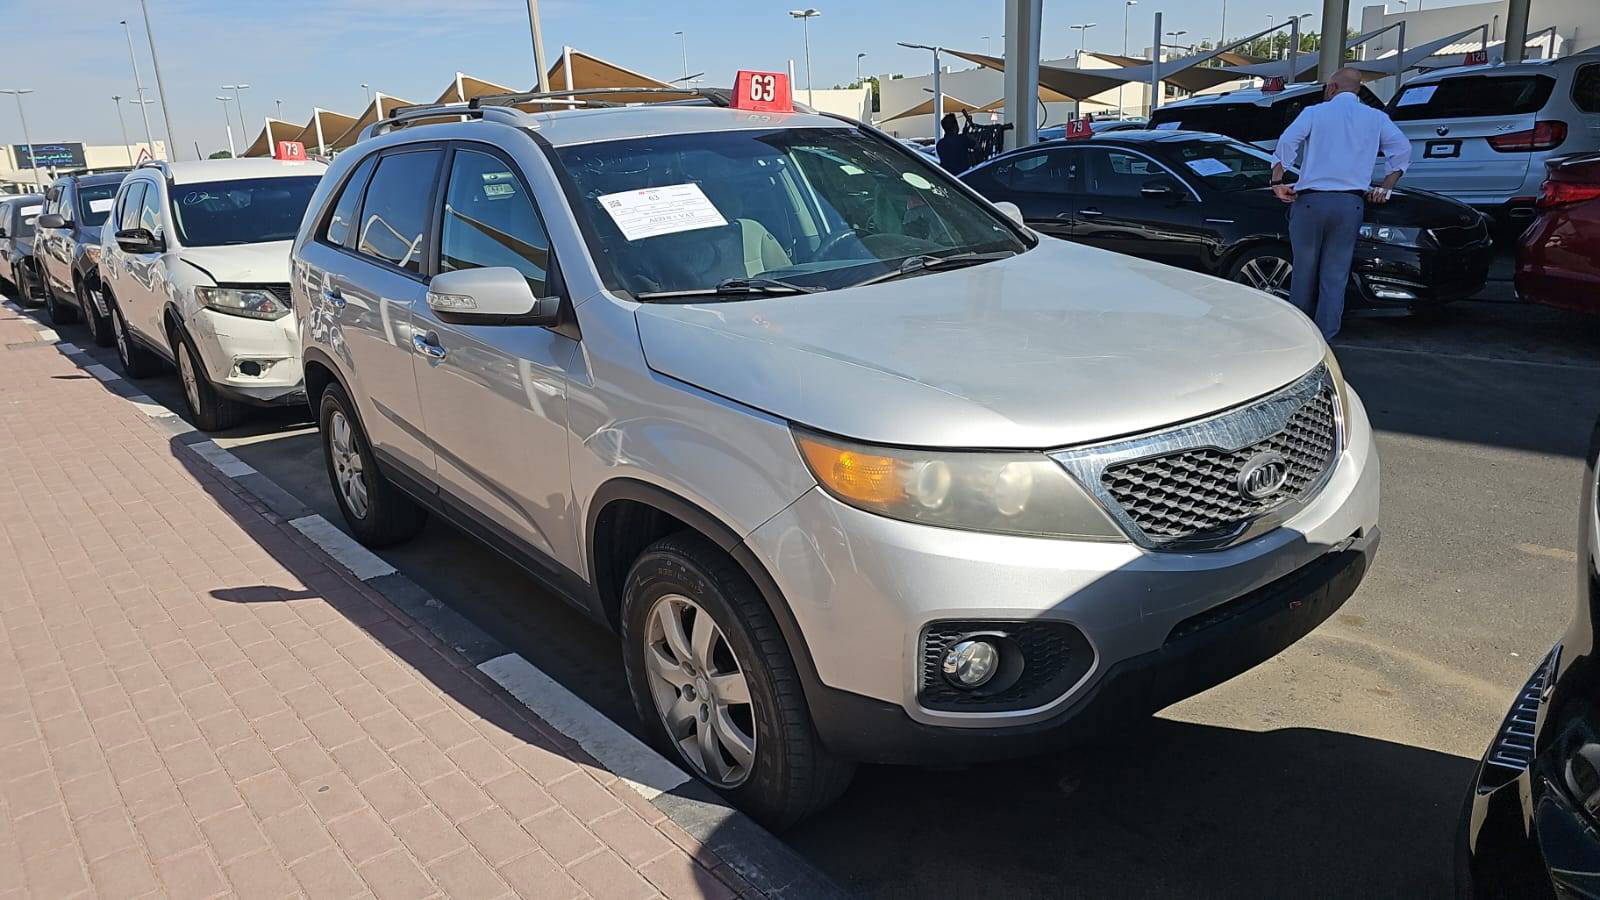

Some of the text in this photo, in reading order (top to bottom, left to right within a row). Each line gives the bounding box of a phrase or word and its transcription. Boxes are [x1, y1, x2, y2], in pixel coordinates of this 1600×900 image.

[751, 74, 775, 102] 63
[1072, 121, 1083, 133] 79
[284, 142, 298, 156] 73
